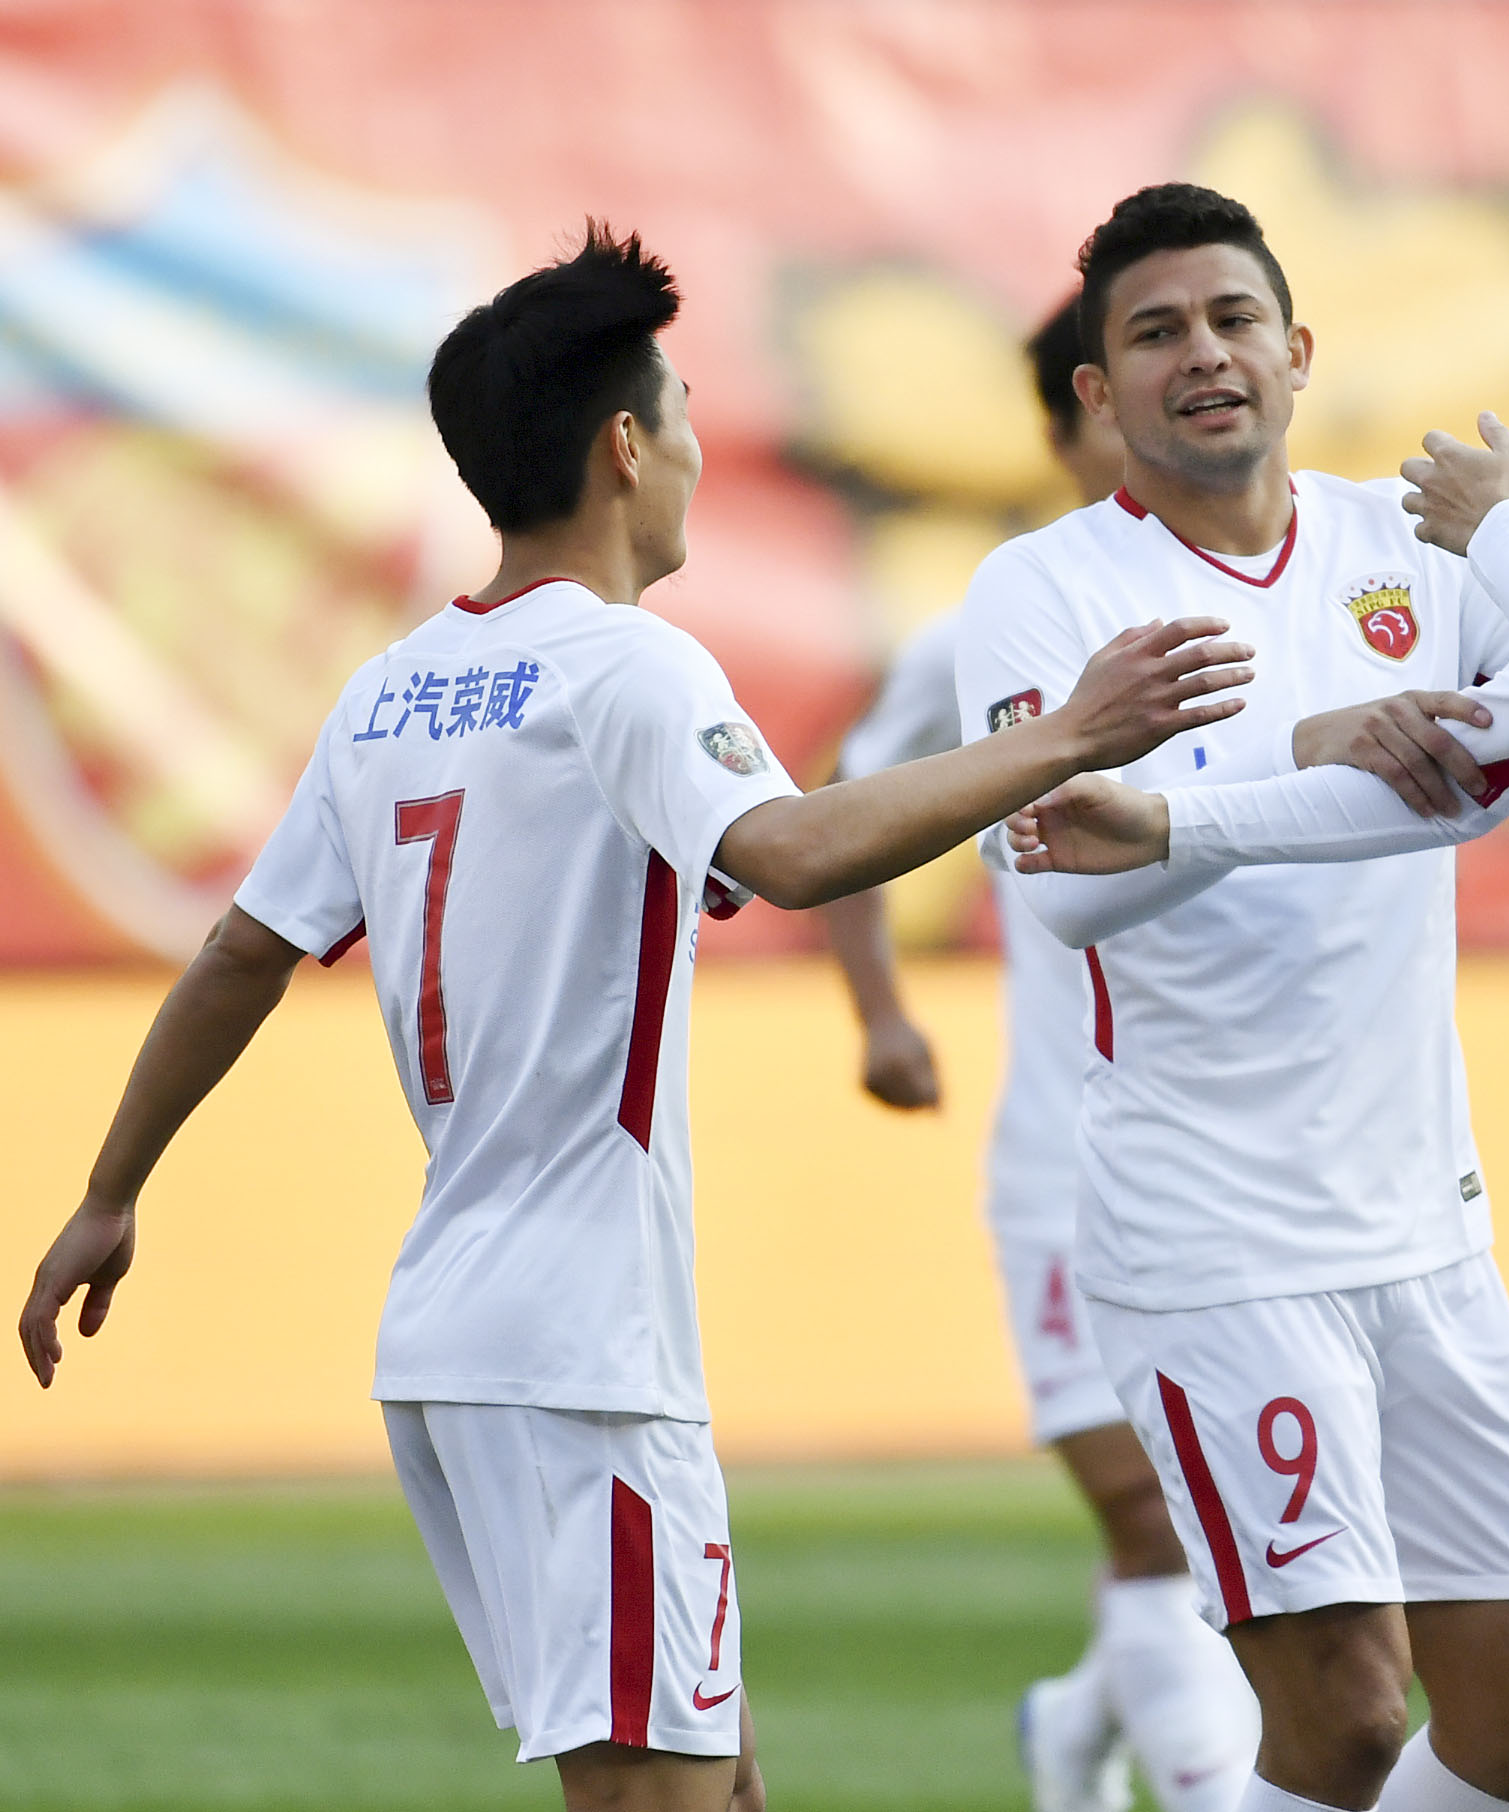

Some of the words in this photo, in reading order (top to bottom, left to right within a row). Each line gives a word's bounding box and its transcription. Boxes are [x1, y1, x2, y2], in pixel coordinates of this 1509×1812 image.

[353, 661, 540, 742] 上汽荣威
[394, 789, 466, 1106] 7
[1257, 1396, 1319, 1525] 9
[703, 1542, 732, 1671] 7
